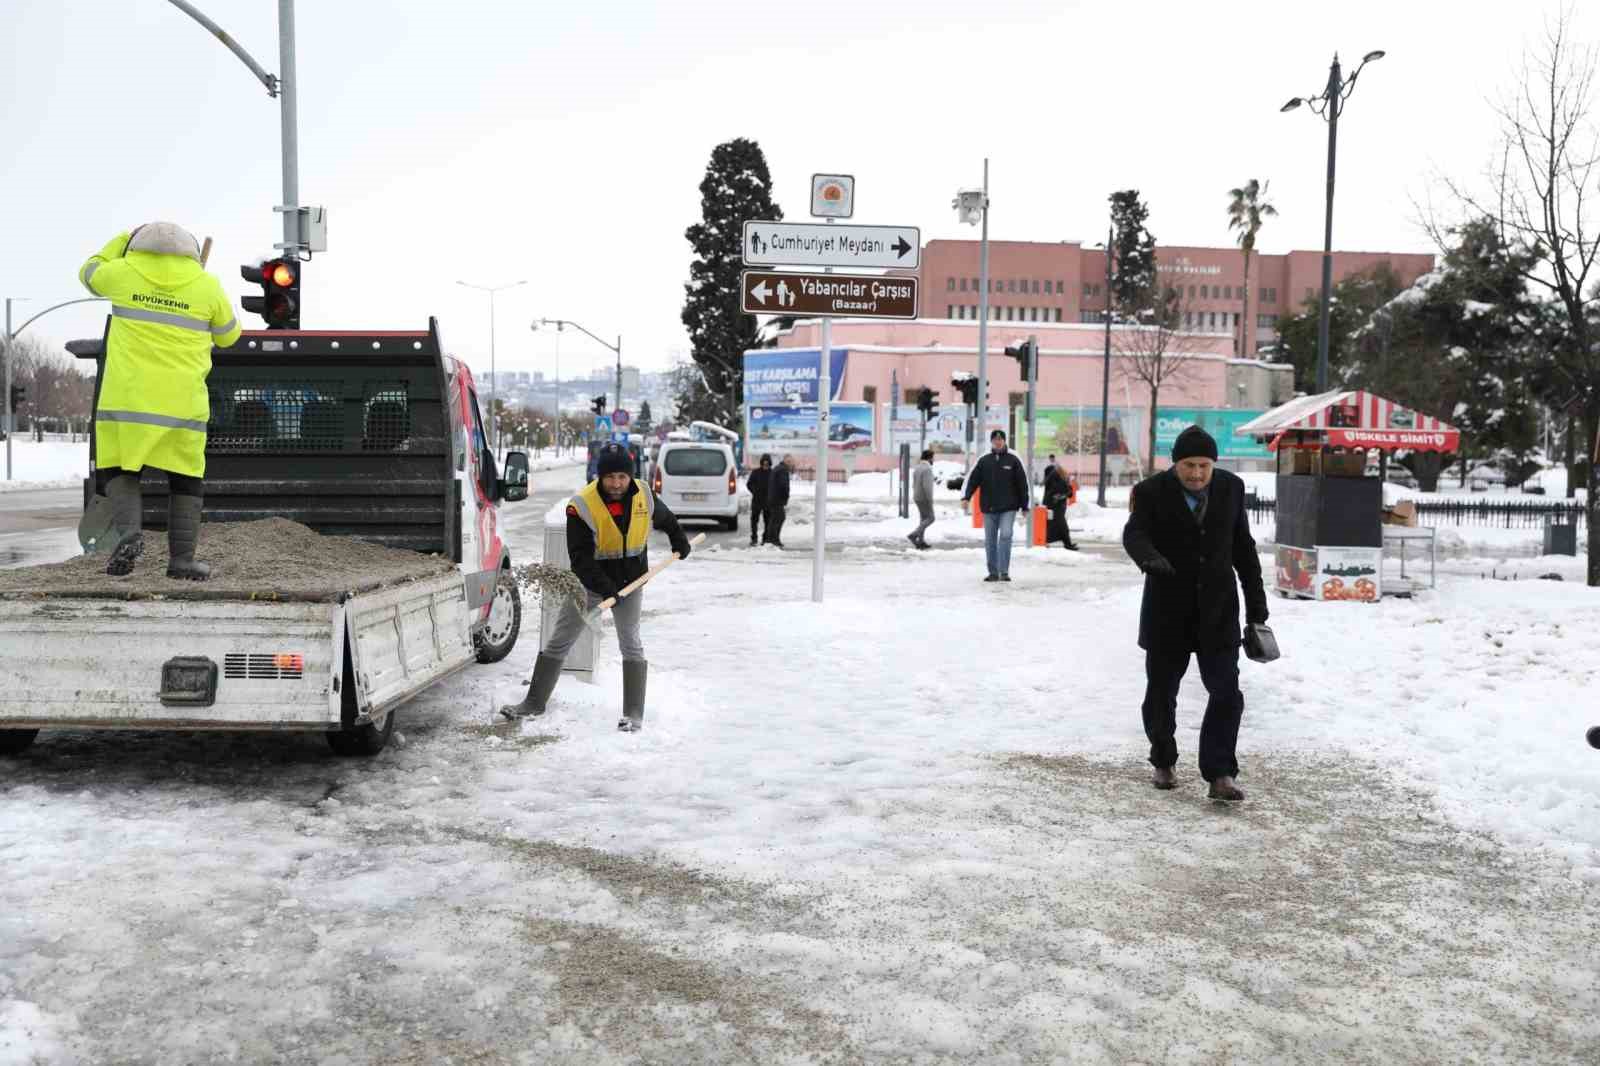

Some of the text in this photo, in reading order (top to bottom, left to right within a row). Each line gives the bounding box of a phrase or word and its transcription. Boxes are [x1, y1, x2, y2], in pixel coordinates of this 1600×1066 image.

[771, 234, 884, 255] Cumhuriyet Meydanı
[799, 279, 912, 299] Yabancılar Çarşısı
[831, 300, 877, 312] (Bazaar)
[820, 411, 828, 421] 2
[1399, 432, 1436, 445] SİMİT
